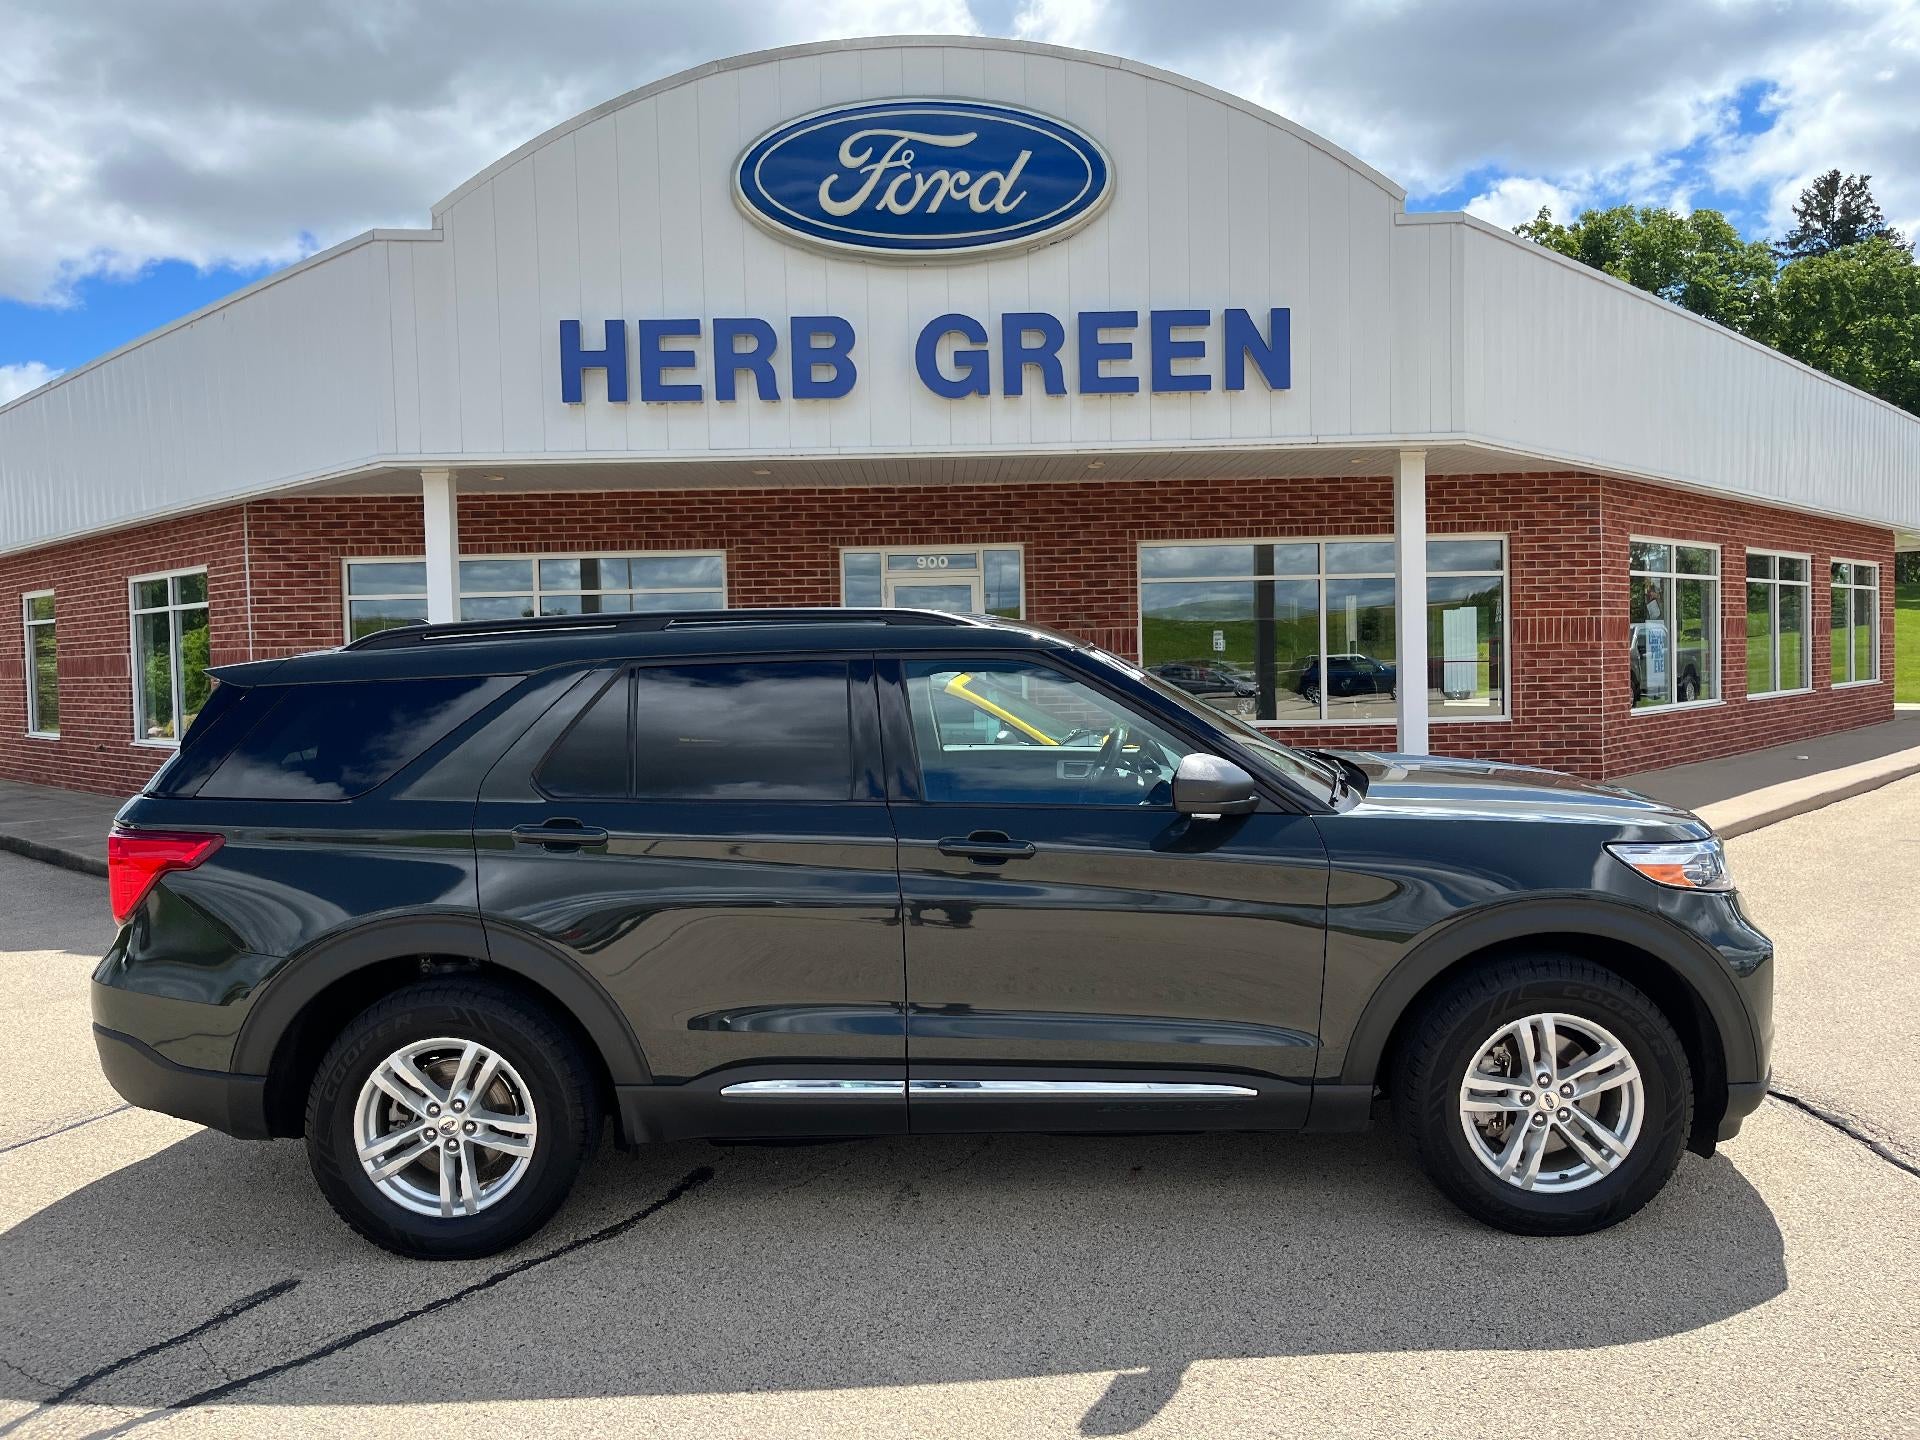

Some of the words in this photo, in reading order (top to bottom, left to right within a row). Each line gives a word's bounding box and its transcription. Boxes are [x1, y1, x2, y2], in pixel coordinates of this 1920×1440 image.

[818, 129, 1031, 217] Ford
[560, 317, 858, 404] HERB
[914, 308, 1292, 400] GREEN
[916, 556, 948, 569] 900
